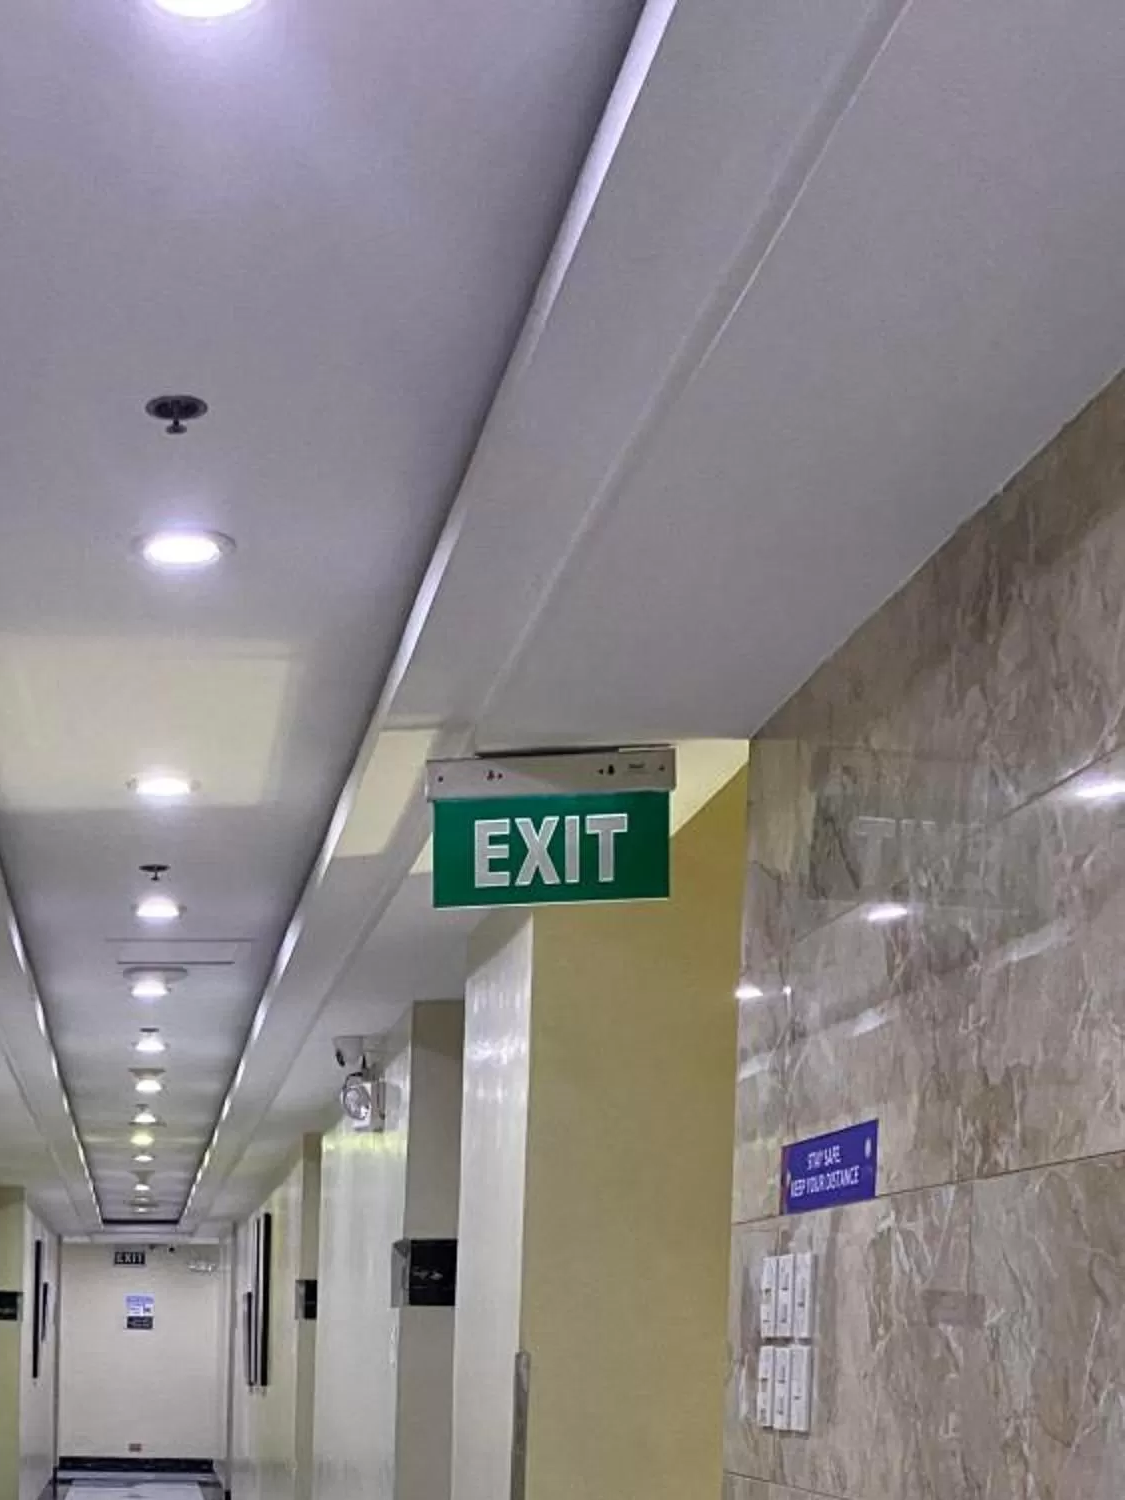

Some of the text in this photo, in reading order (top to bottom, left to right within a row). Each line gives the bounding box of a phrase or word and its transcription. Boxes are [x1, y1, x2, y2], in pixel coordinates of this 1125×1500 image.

[474, 812, 628, 888] EXIT
[806, 1144, 842, 1171] STAY SAFE
[790, 1165, 860, 1198] KEEP YOUR DISTANCE
[116, 1252, 143, 1263] EXIT
